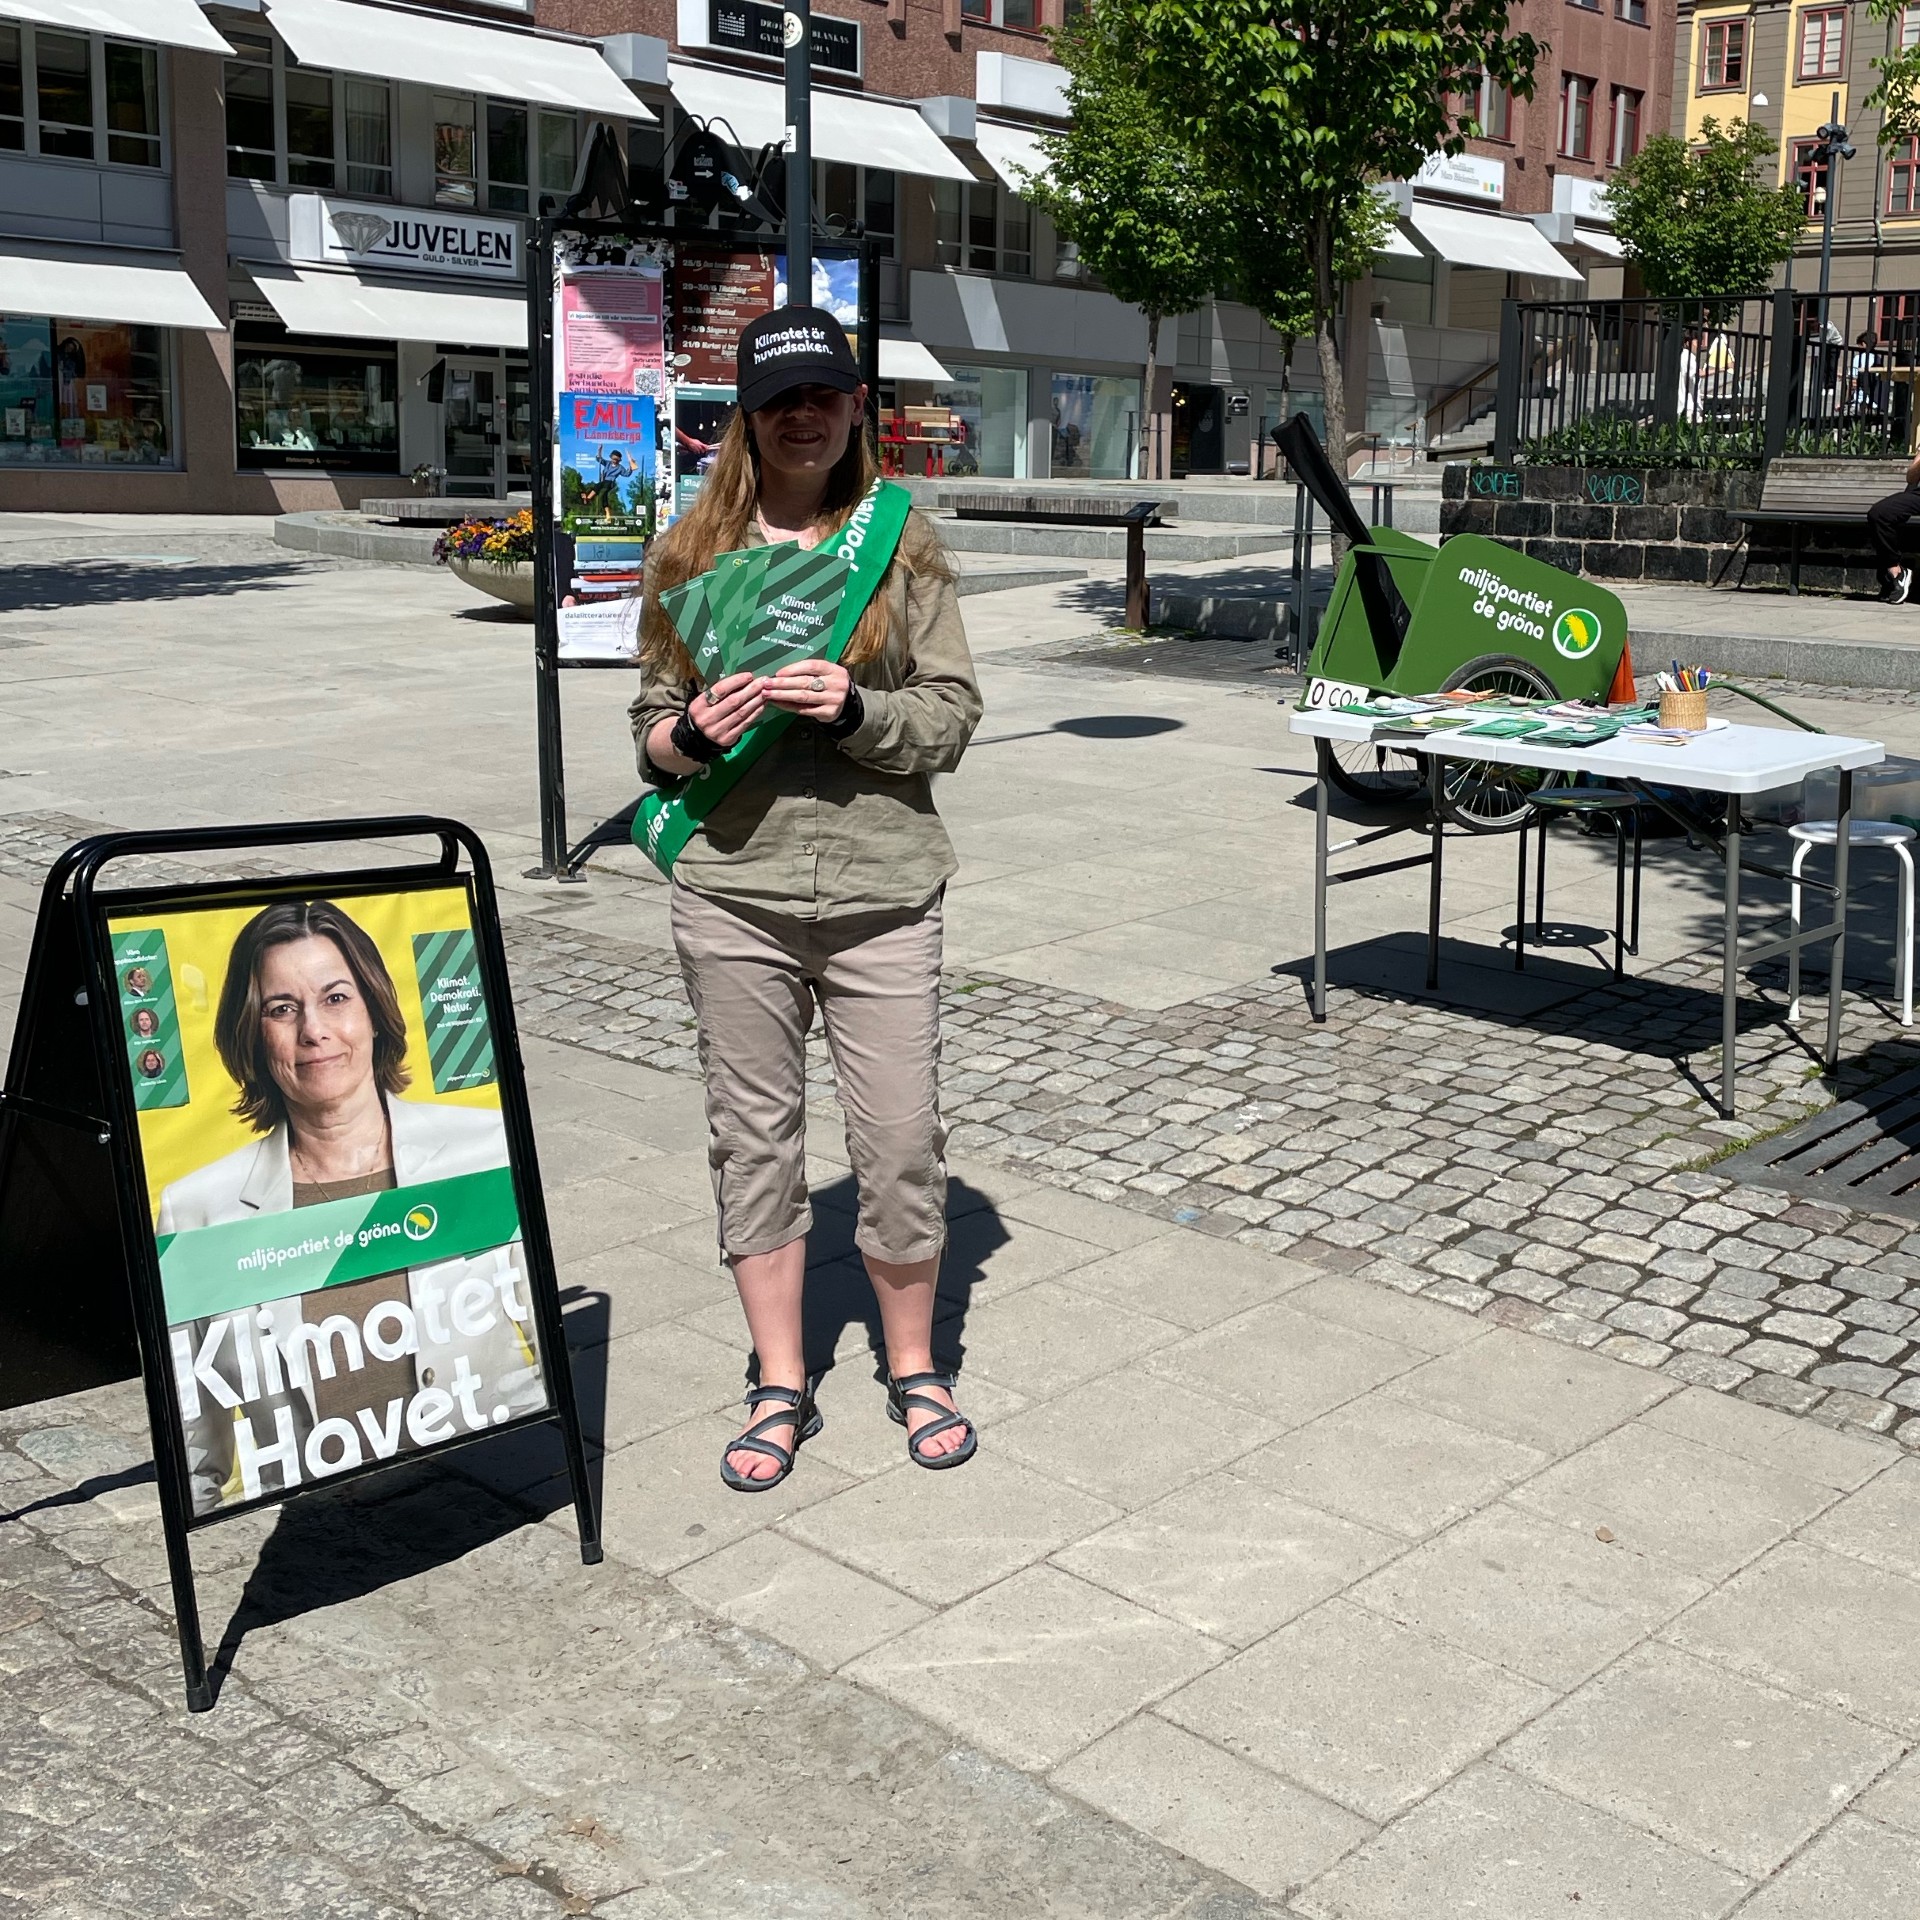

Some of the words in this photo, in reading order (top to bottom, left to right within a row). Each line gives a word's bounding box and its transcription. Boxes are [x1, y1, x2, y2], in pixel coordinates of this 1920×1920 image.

[386, 220, 512, 261] JUVELEN
[422, 253, 445, 264] GULD
[451, 256, 479, 267] SILVER
[755, 326, 810, 350] Klimatet
[811, 327, 826, 340] är
[753, 340, 834, 365] huvudsaken.
[574, 399, 641, 430] EMIL
[780, 594, 818, 612] Klimat.
[1458, 566, 1553, 619] miljöpartiet
[766, 604, 825, 627] Demokrati.
[1472, 598, 1495, 619] de
[1497, 610, 1545, 641] gröna
[775, 621, 809, 637] Natur.
[436, 975, 470, 989] Klimat.
[430, 986, 482, 1003] Demokrati.
[443, 1001, 473, 1015] Natur.
[237, 1235, 330, 1273] miljöpartiet
[333, 1229, 355, 1247] de
[358, 1221, 401, 1248] gröna
[170, 1247, 529, 1421] Klimatet
[233, 1355, 511, 1501] Havet.
